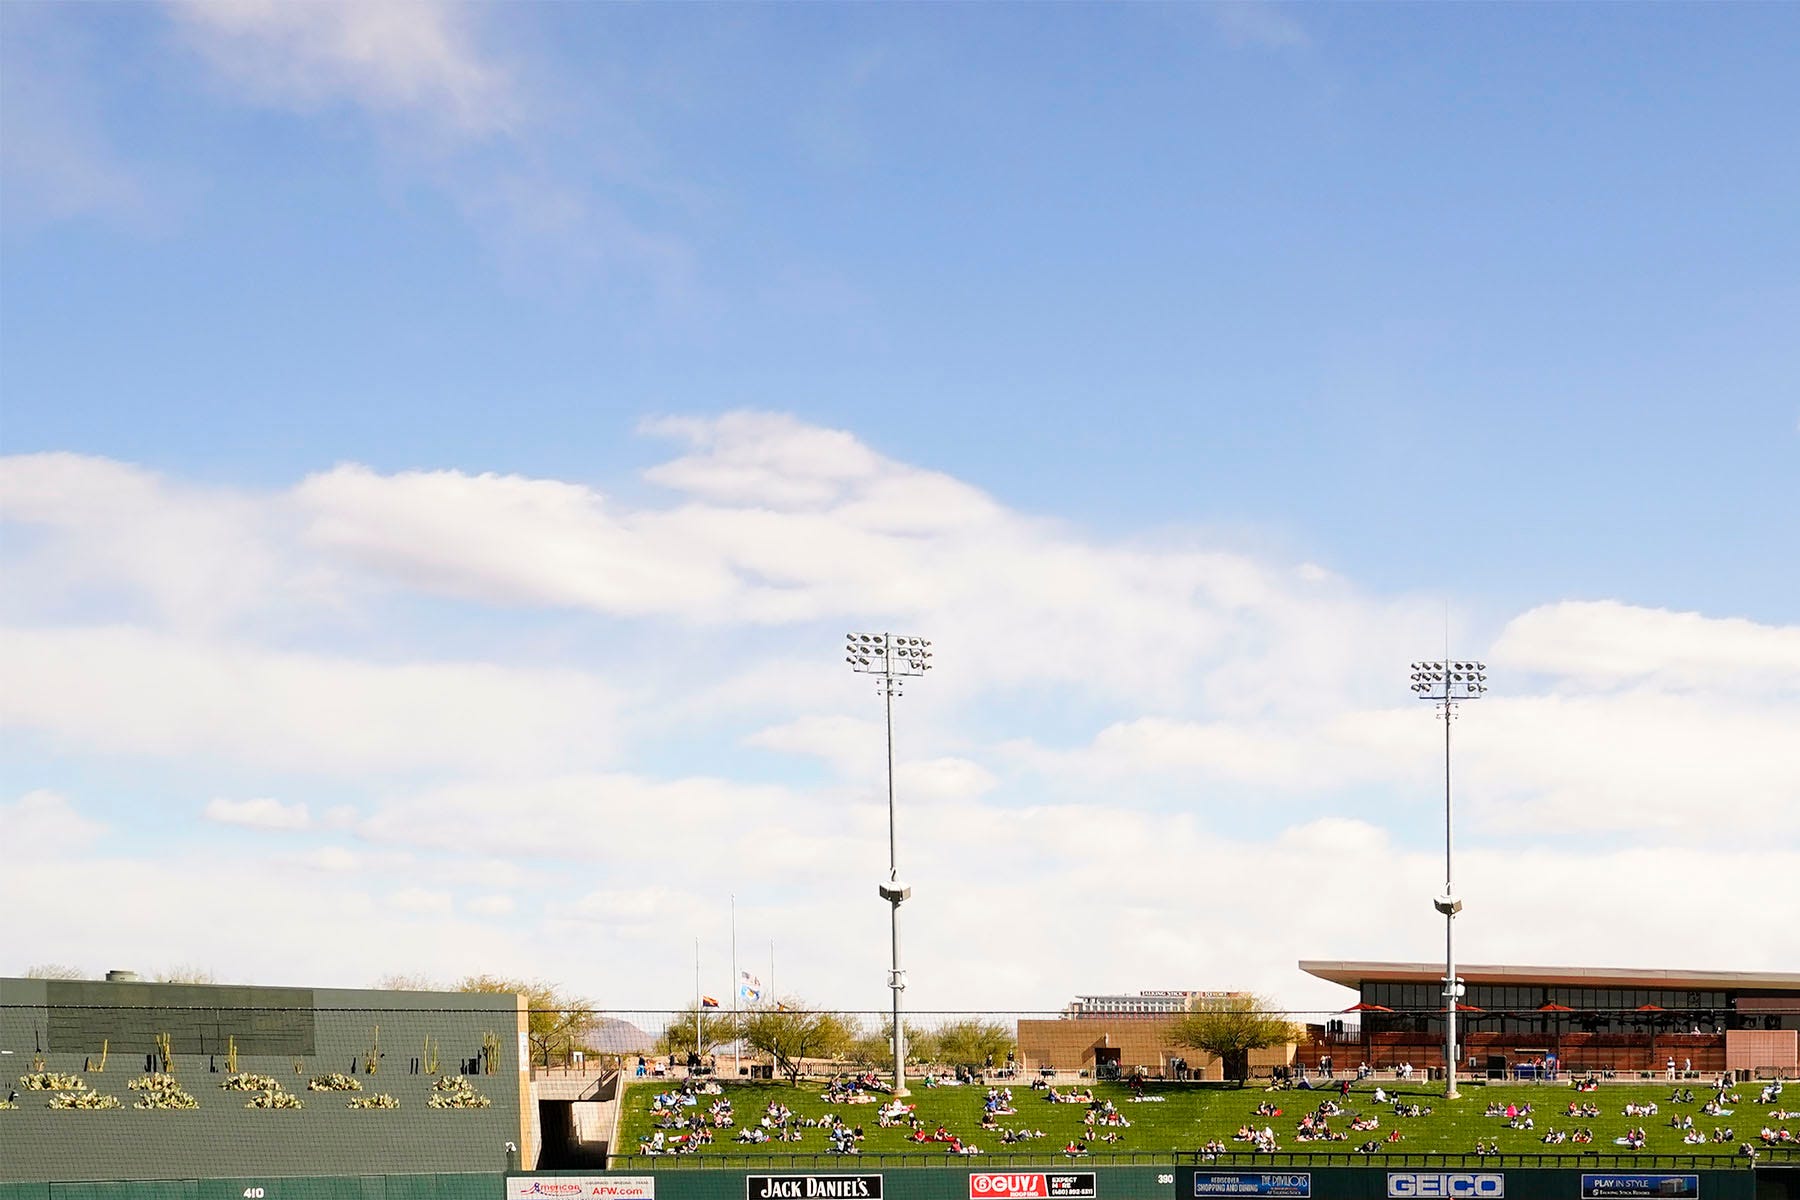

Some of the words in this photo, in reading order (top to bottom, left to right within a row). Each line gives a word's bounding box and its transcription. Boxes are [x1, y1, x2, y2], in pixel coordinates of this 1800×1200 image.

[992, 1176, 1038, 1192] GUYS
[1158, 1175, 1173, 1184] 390
[1626, 1180, 1649, 1188] STYLE
[761, 1178, 802, 1198] JACK
[1389, 1174, 1502, 1196] GEICO
[243, 1188, 264, 1198] 410
[592, 1187, 643, 1195] AFW.com
